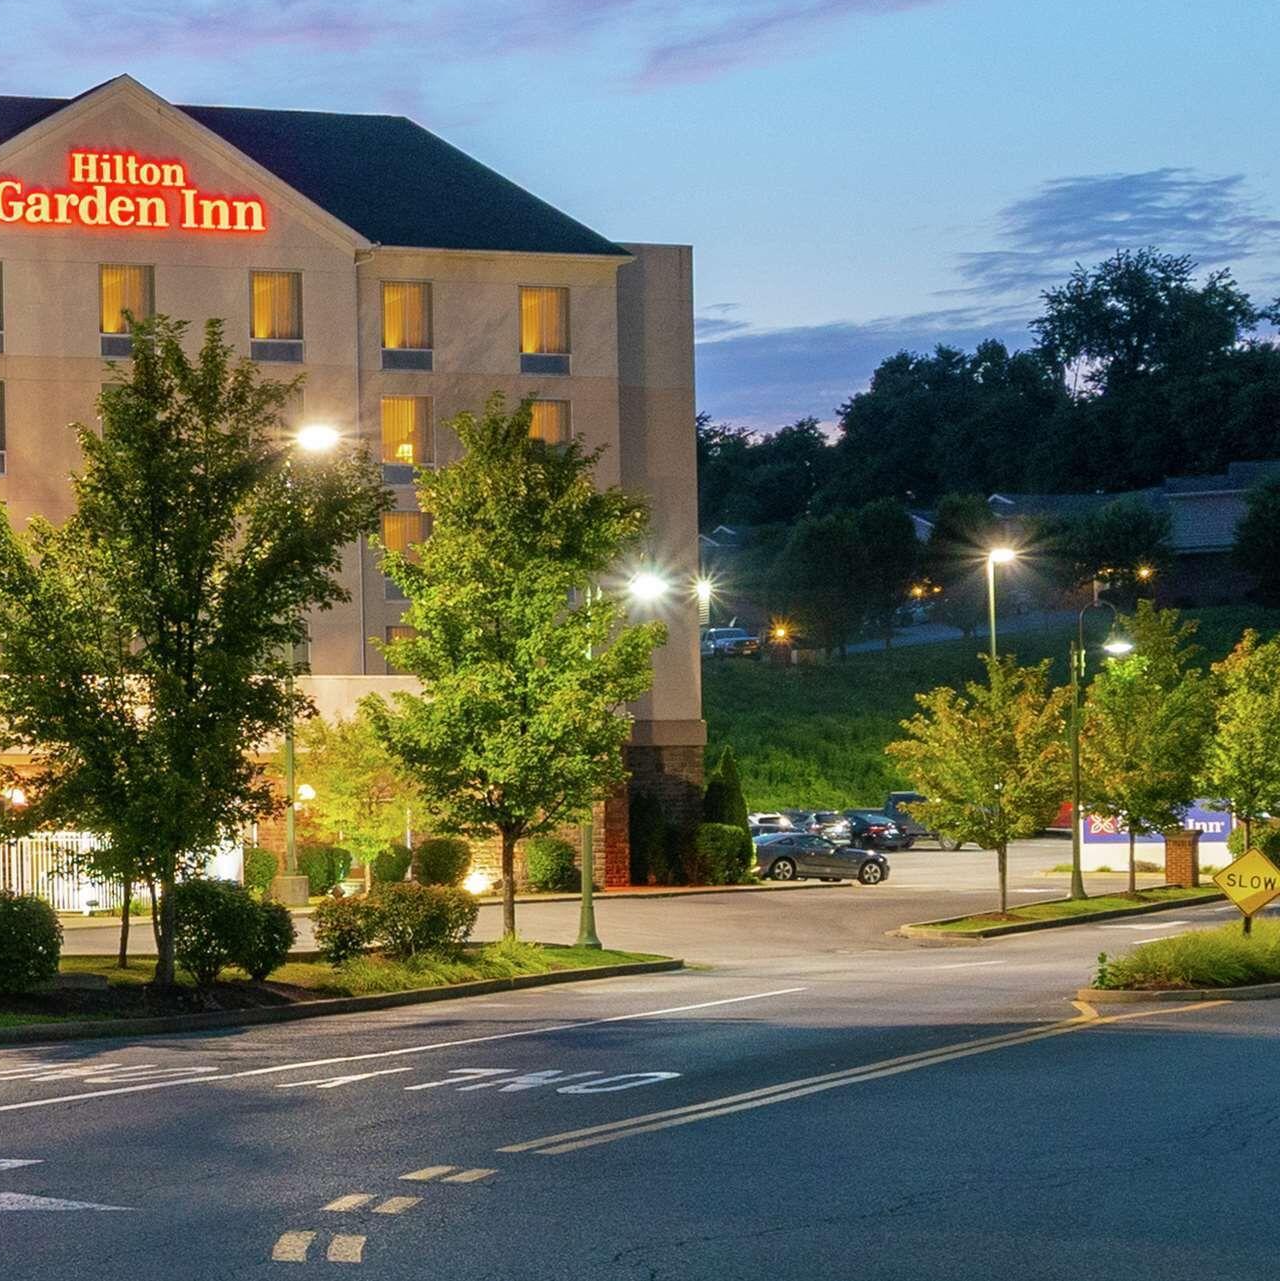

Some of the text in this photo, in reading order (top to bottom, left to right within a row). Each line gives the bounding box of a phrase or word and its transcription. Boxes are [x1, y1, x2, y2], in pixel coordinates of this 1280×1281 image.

[71, 152, 187, 188] Hilton
[180, 188, 267, 232] Inn
[1226, 873, 1277, 891] SLOW
